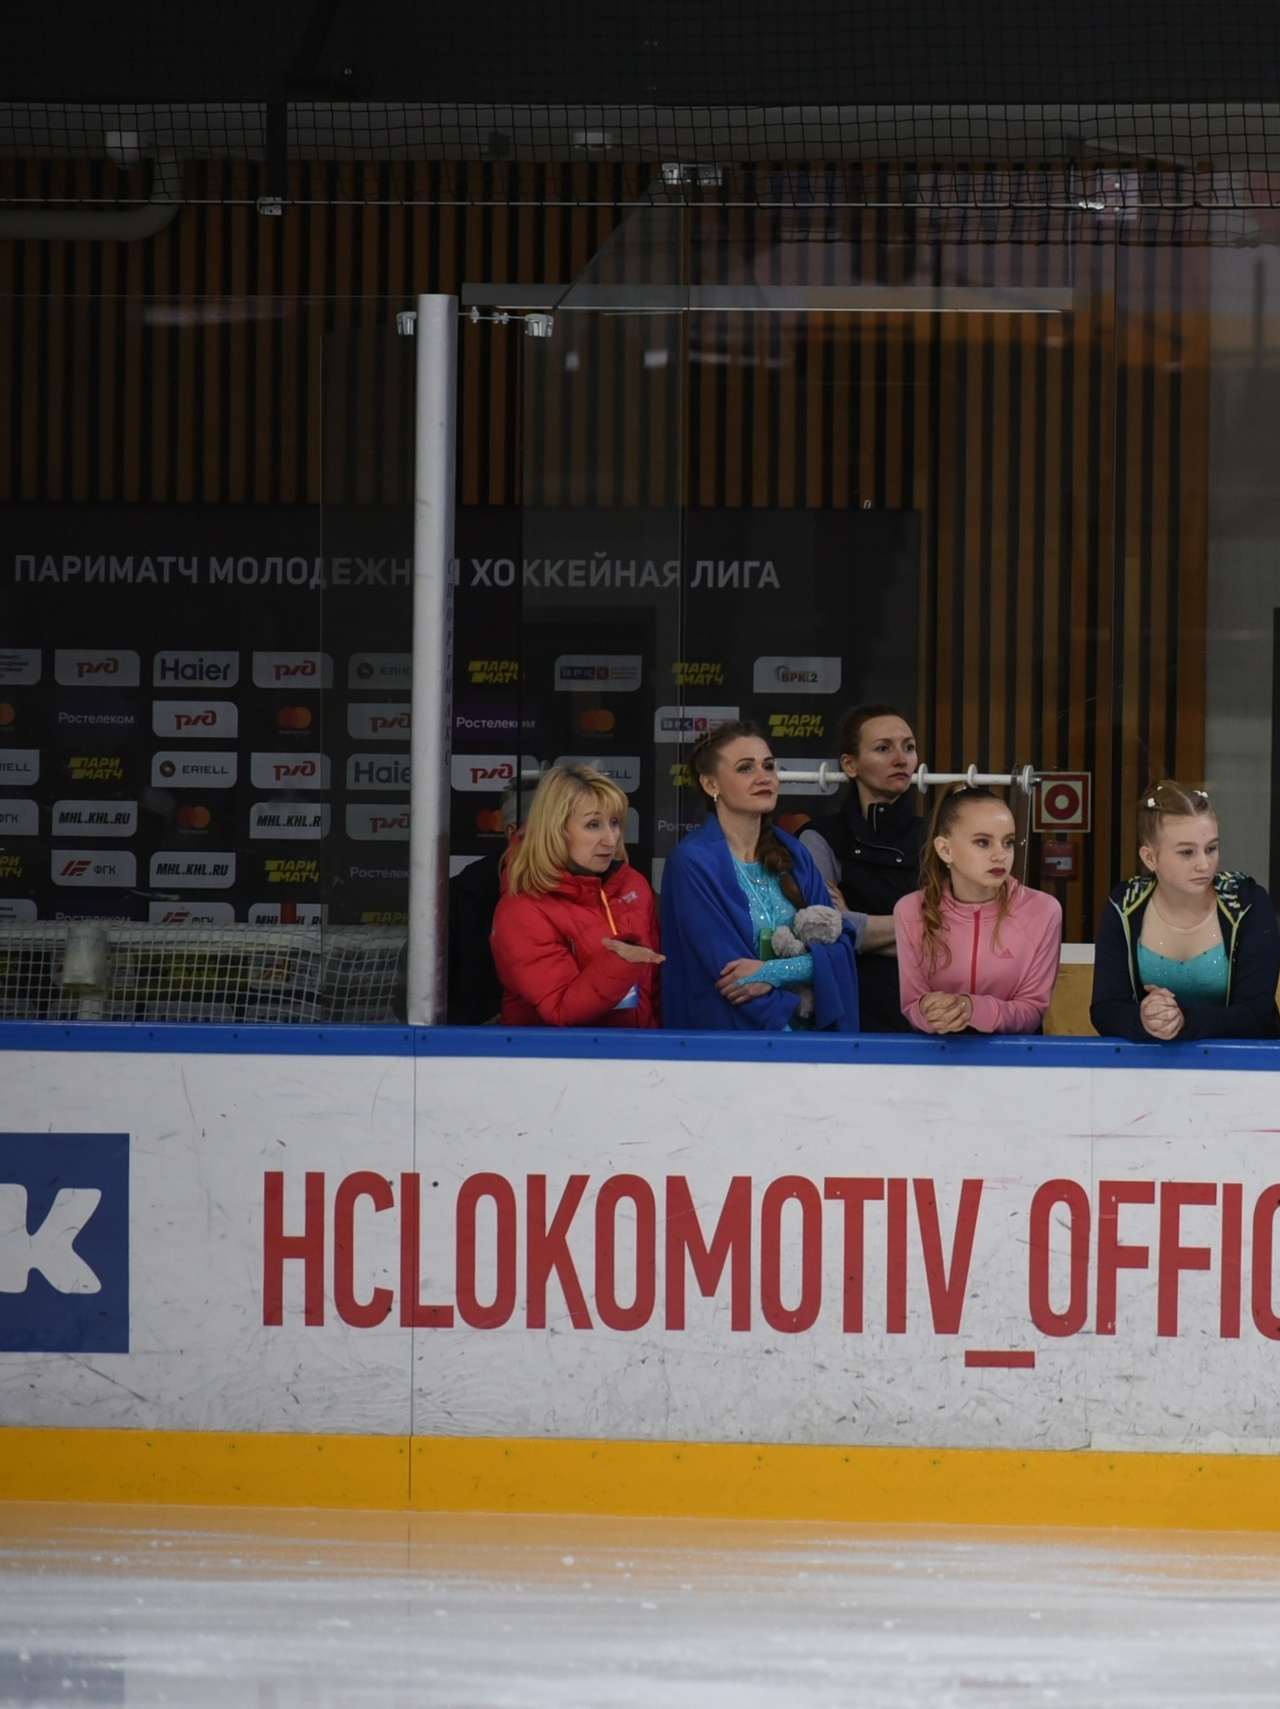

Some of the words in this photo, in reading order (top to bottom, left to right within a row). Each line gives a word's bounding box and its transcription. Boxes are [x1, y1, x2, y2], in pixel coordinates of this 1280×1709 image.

[14, 554, 199, 584] ПАРИМАТЧ
[208, 556, 460, 590] МОЛОДЕЖН
[470, 550, 681, 588] ХОККЕЙНАЯ
[690, 560, 781, 589] ЛИГА
[160, 658, 231, 681] Haier
[379, 667, 411, 676] ERIE
[475, 661, 519, 672] ПАРИ
[679, 662, 721, 673] ПАРИ
[680, 674, 724, 685] МАТЧ
[58, 712, 135, 725] Ростелеком
[776, 715, 822, 726] ПАРИ
[780, 726, 825, 737] МАТЧ
[79, 757, 121, 767] ПАРИ
[82, 768, 124, 779] МАТЧ
[182, 765, 229, 775] ERIELL
[354, 760, 410, 784] Haie
[58, 812, 131, 826] MHL.KHL.RU
[94, 865, 116, 875] ФГК
[156, 863, 229, 877] MHL.KHL.RU
[272, 860, 318, 871] ПАРИ
[276, 871, 319, 883] МАТЧ
[350, 866, 409, 879] Ростелек
